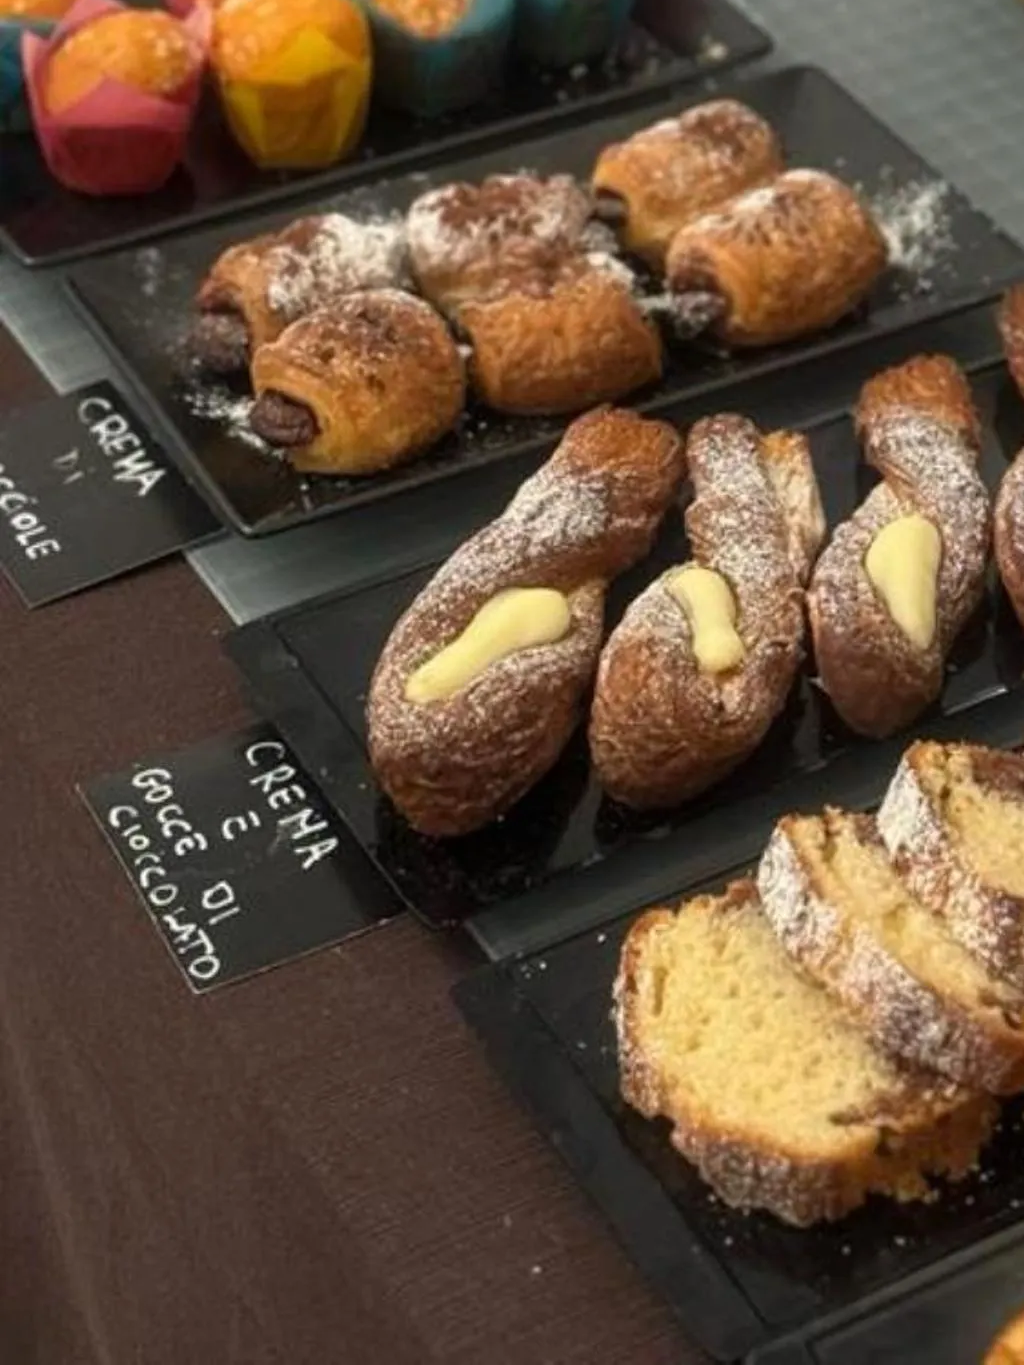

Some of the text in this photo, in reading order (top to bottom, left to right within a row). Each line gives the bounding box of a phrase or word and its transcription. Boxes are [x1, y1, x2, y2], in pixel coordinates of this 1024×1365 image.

[77, 396, 167, 497] CREMA
[131, 767, 241, 926] GOCCE DI
[246, 741, 339, 870] CREMA
[108, 804, 221, 980] CIOCCOLATO
